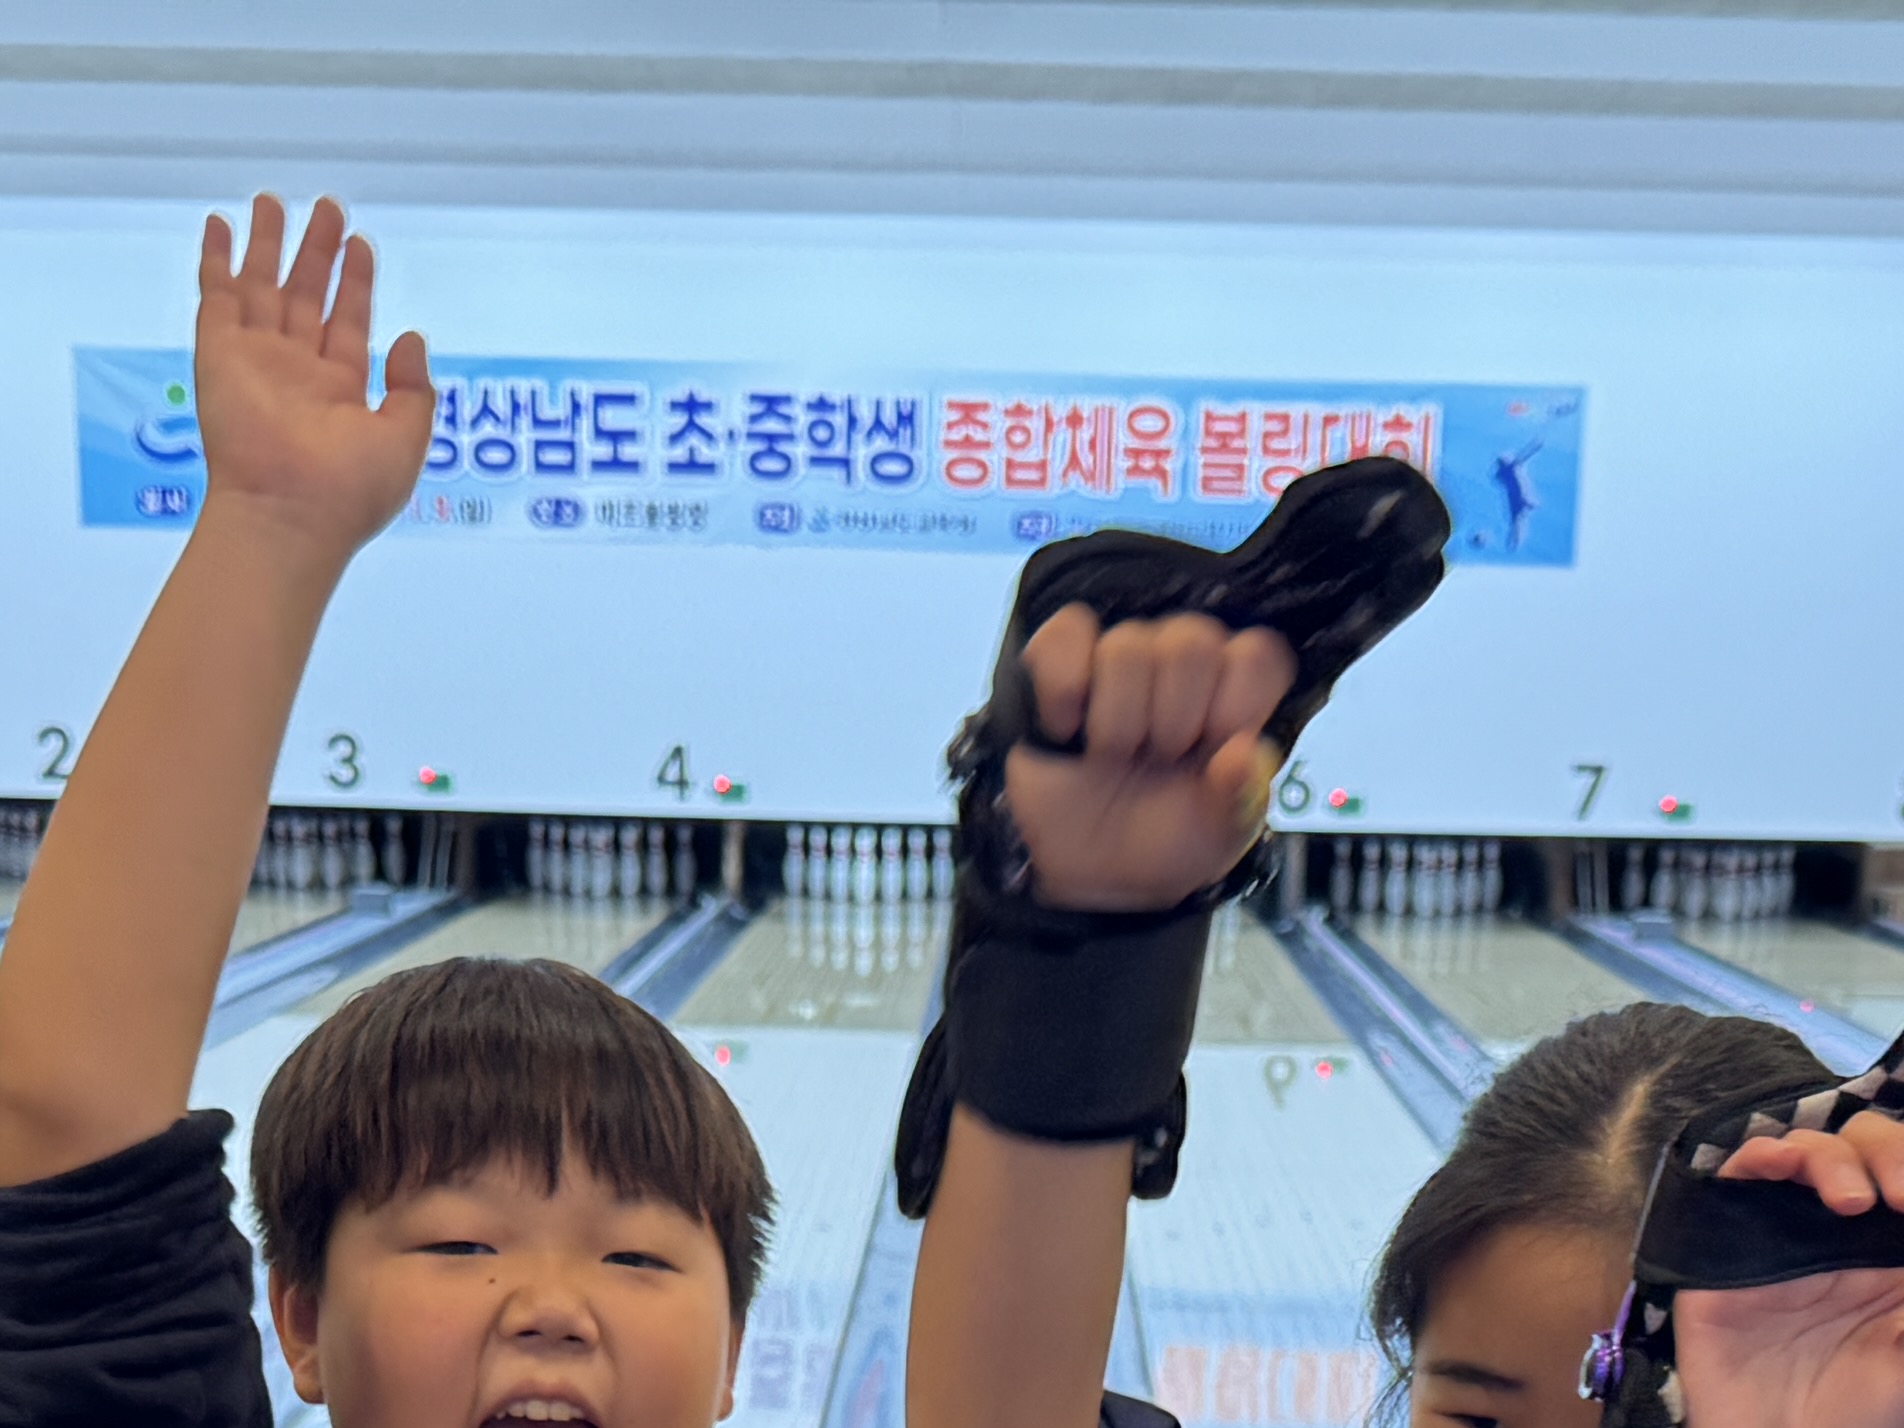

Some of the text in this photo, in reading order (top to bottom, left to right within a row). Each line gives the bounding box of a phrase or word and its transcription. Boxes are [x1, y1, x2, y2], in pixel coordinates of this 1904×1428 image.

[943, 400, 1171, 498] 종합체육
[37, 726, 73, 780] 2
[326, 734, 360, 788] 3
[656, 744, 689, 801] 4
[1278, 764, 1312, 813] 6
[1572, 764, 1607, 820] 7
